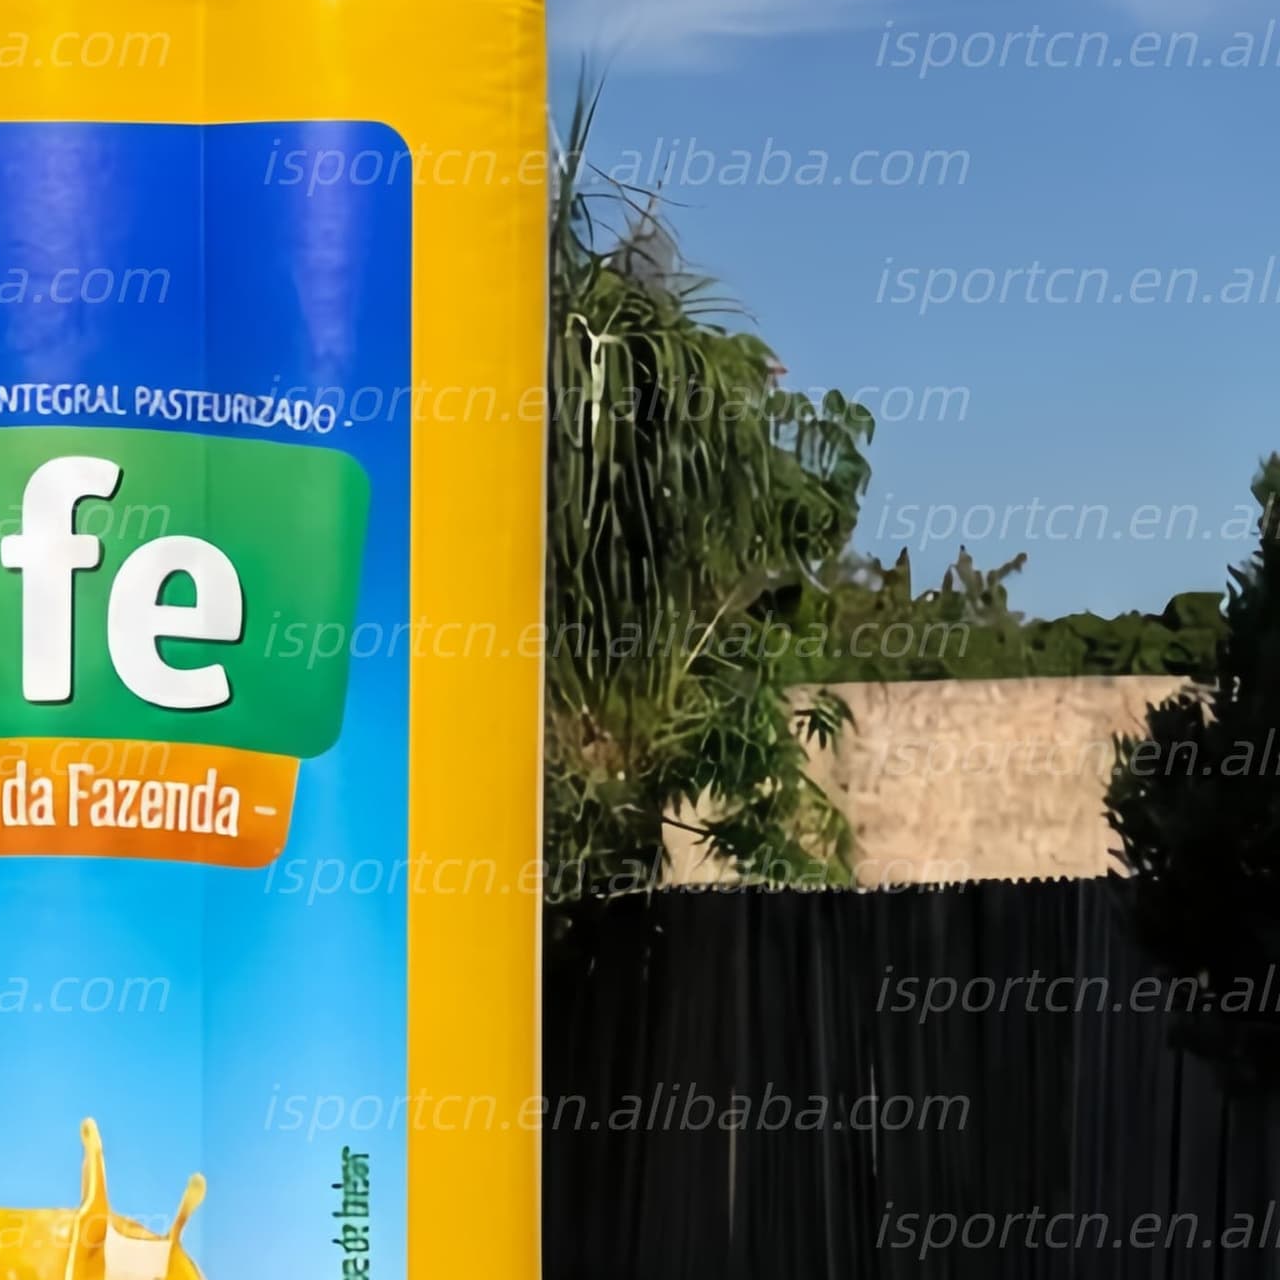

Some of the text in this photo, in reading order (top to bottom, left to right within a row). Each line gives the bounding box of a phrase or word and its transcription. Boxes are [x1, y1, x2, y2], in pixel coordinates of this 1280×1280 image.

[134, 385, 336, 434] PASTEURIZADO
[2, 760, 56, 827] da
[68, 762, 240, 838] Fazenda
